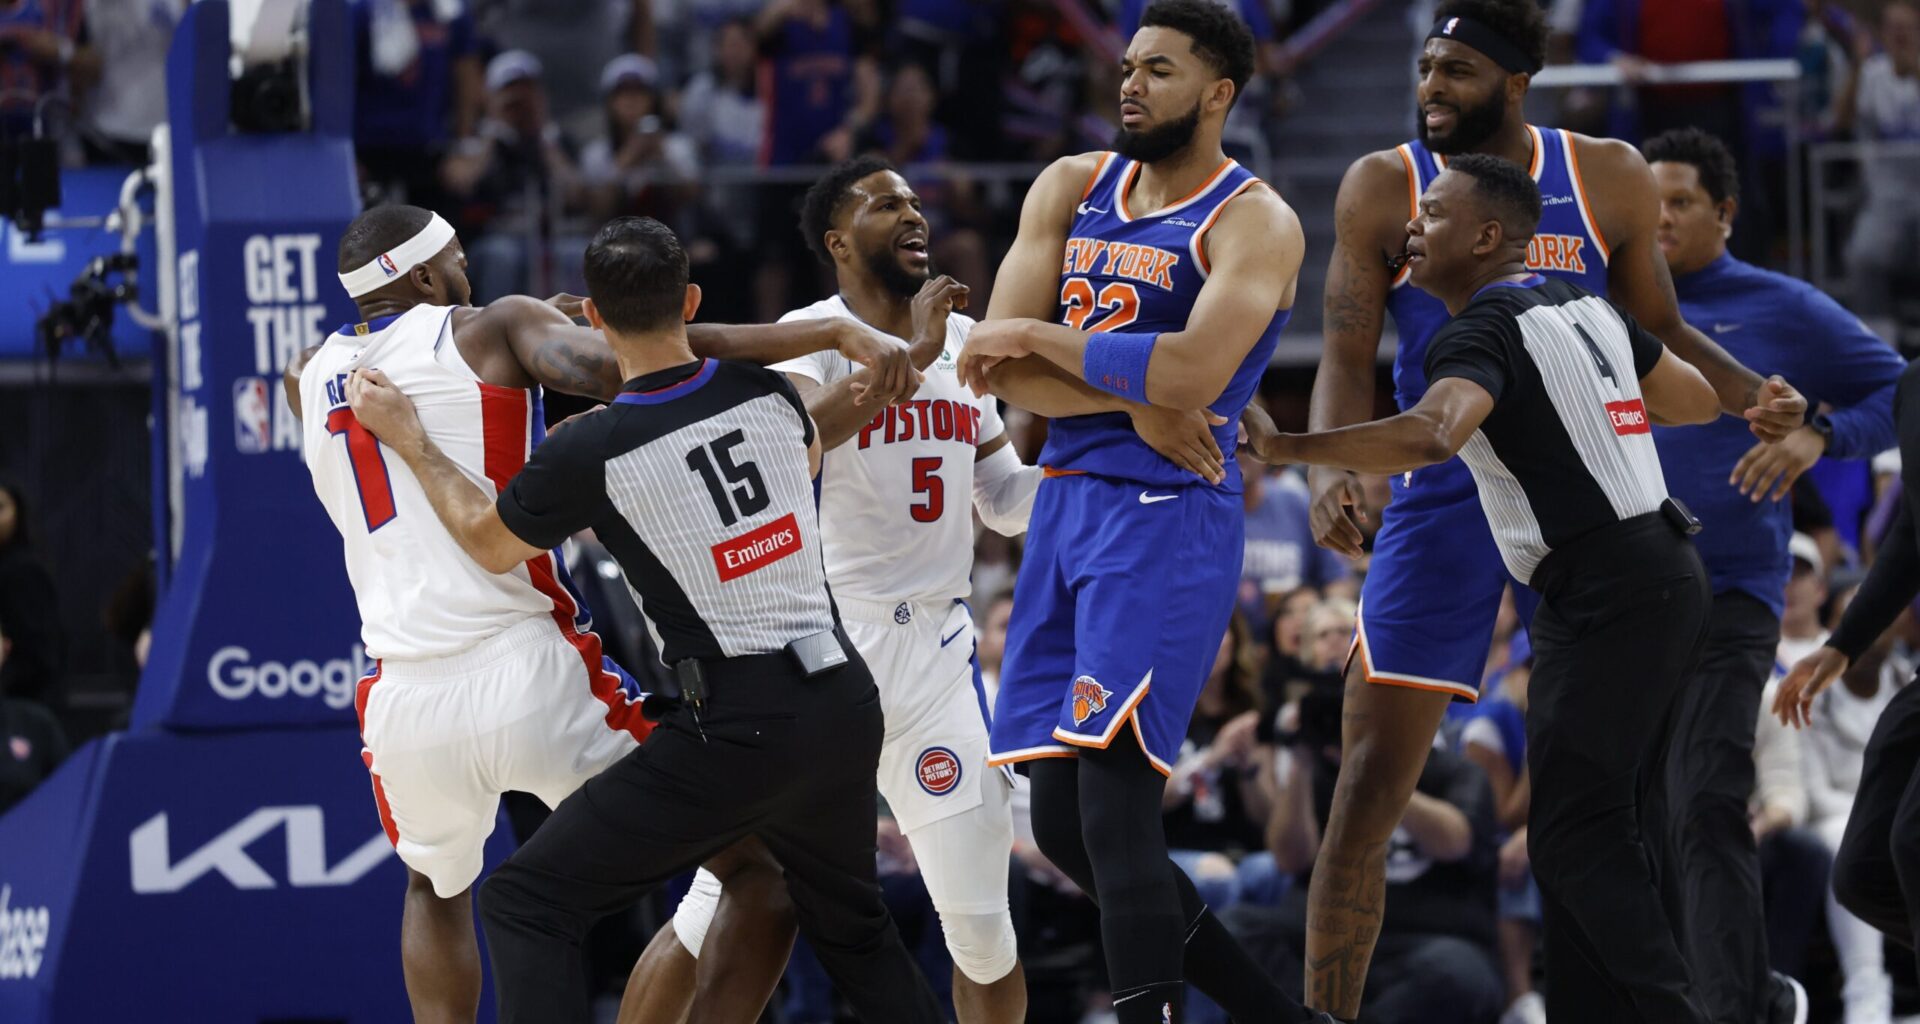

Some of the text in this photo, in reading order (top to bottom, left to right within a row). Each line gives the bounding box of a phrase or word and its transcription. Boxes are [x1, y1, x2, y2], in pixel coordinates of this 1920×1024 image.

[243, 234, 322, 304] GET
[1061, 237, 1180, 292] EW YORK
[1524, 233, 1587, 275] ORK
[1060, 277, 1141, 334] 32
[246, 304, 327, 375] THE
[1572, 322, 1619, 389] 4
[858, 398, 982, 451] PISTONS
[685, 428, 770, 528] 15
[909, 456, 945, 523] 5
[723, 528, 794, 570] Emirates
[207, 643, 377, 710] Googl
[925, 767, 954, 783] PISTONS
